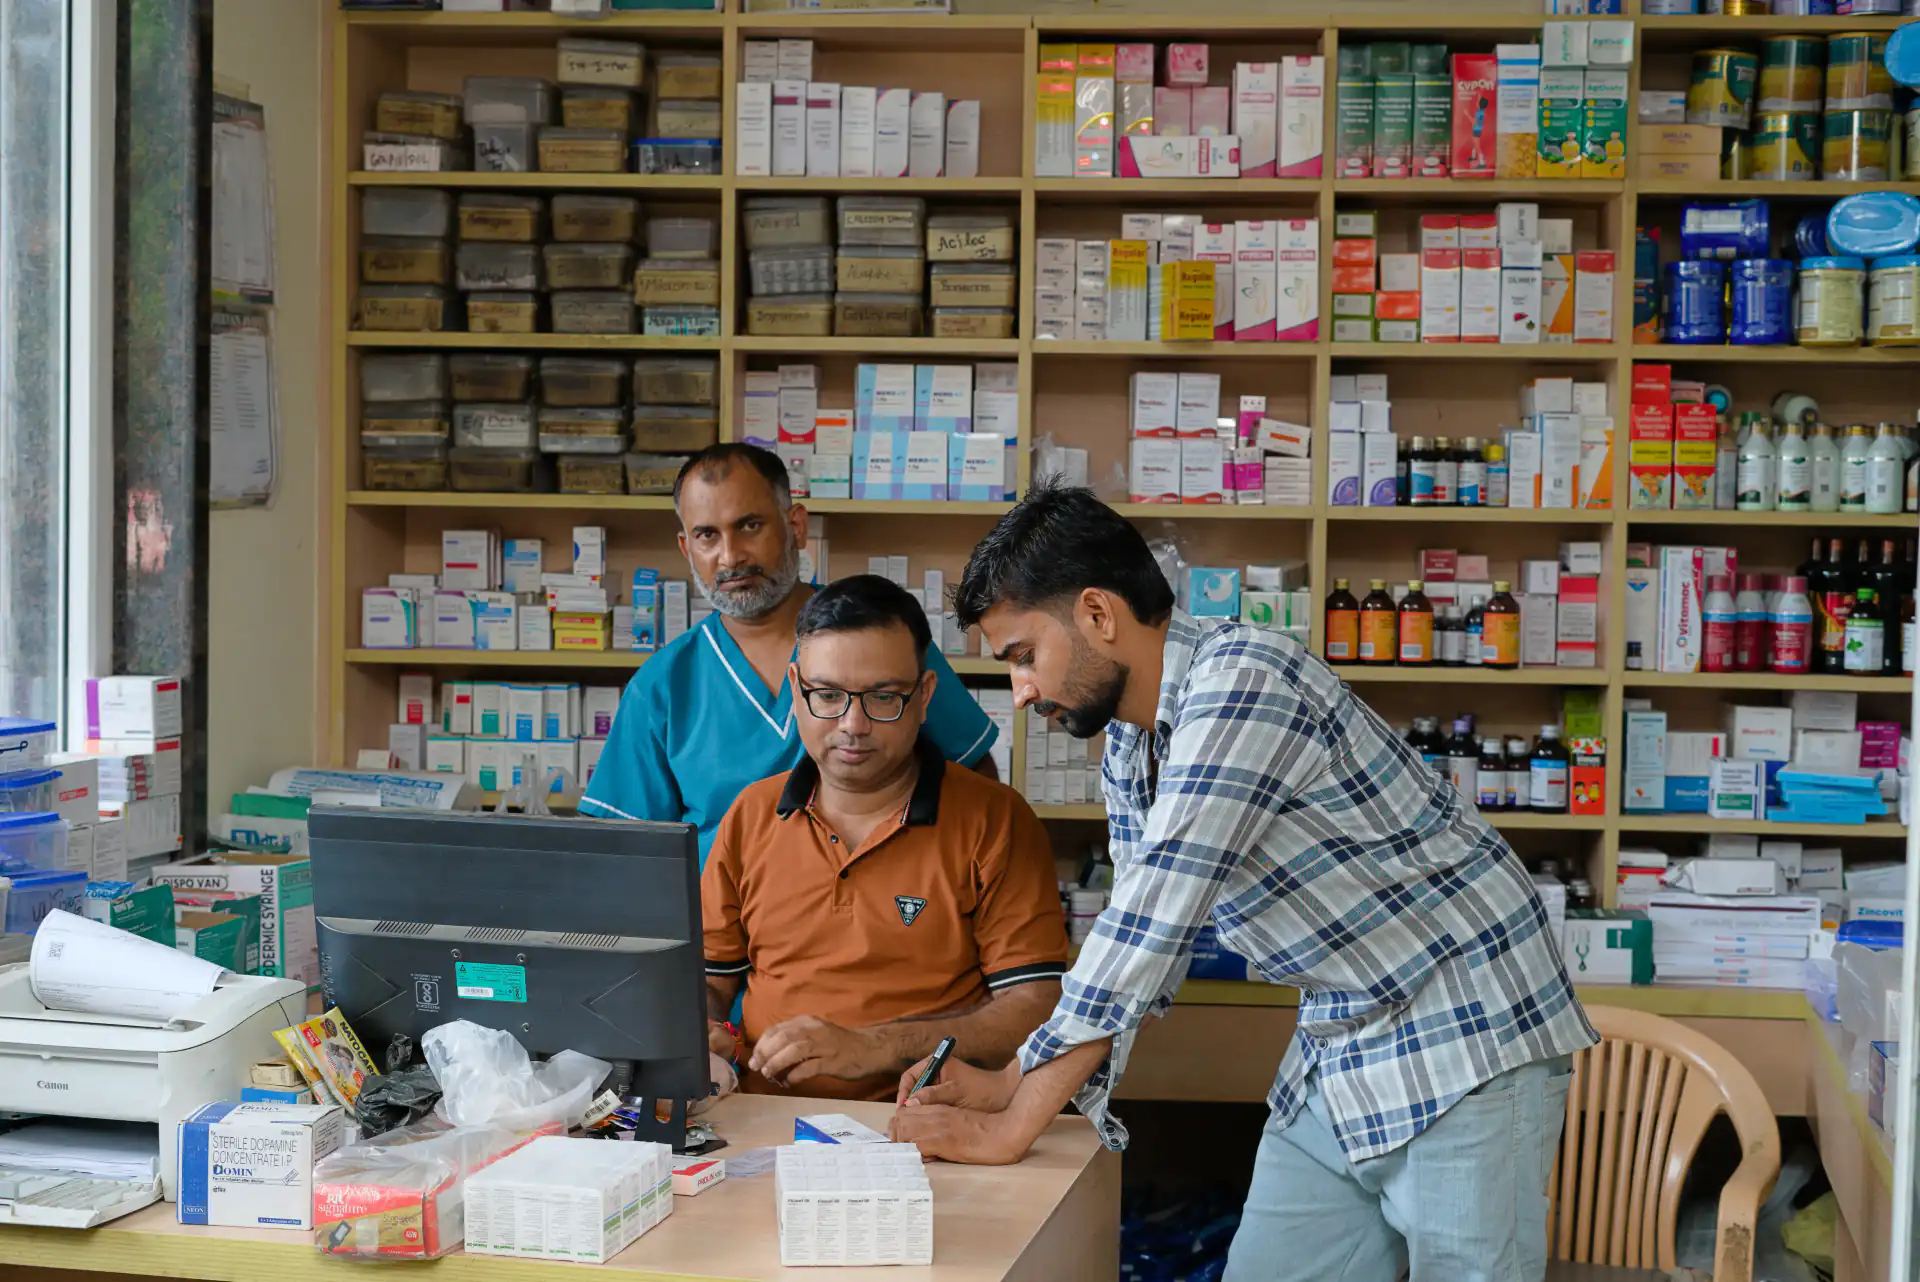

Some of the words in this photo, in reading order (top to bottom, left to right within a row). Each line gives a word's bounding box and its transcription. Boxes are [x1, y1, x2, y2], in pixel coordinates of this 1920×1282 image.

[1181, 271, 1213, 283] Regular
[1179, 310, 1212, 323] Regular
[198, 878, 221, 888] VAN
[260, 868, 275, 921] SYRINGE
[1857, 907, 1905, 917] Zincovit
[36, 1080, 69, 1091] Canon
[212, 1135, 248, 1150] STERILE
[250, 1137, 298, 1153] DOPAMINE
[212, 1150, 280, 1167] CONCENTRATE
[212, 1164, 253, 1176] DOMIN
